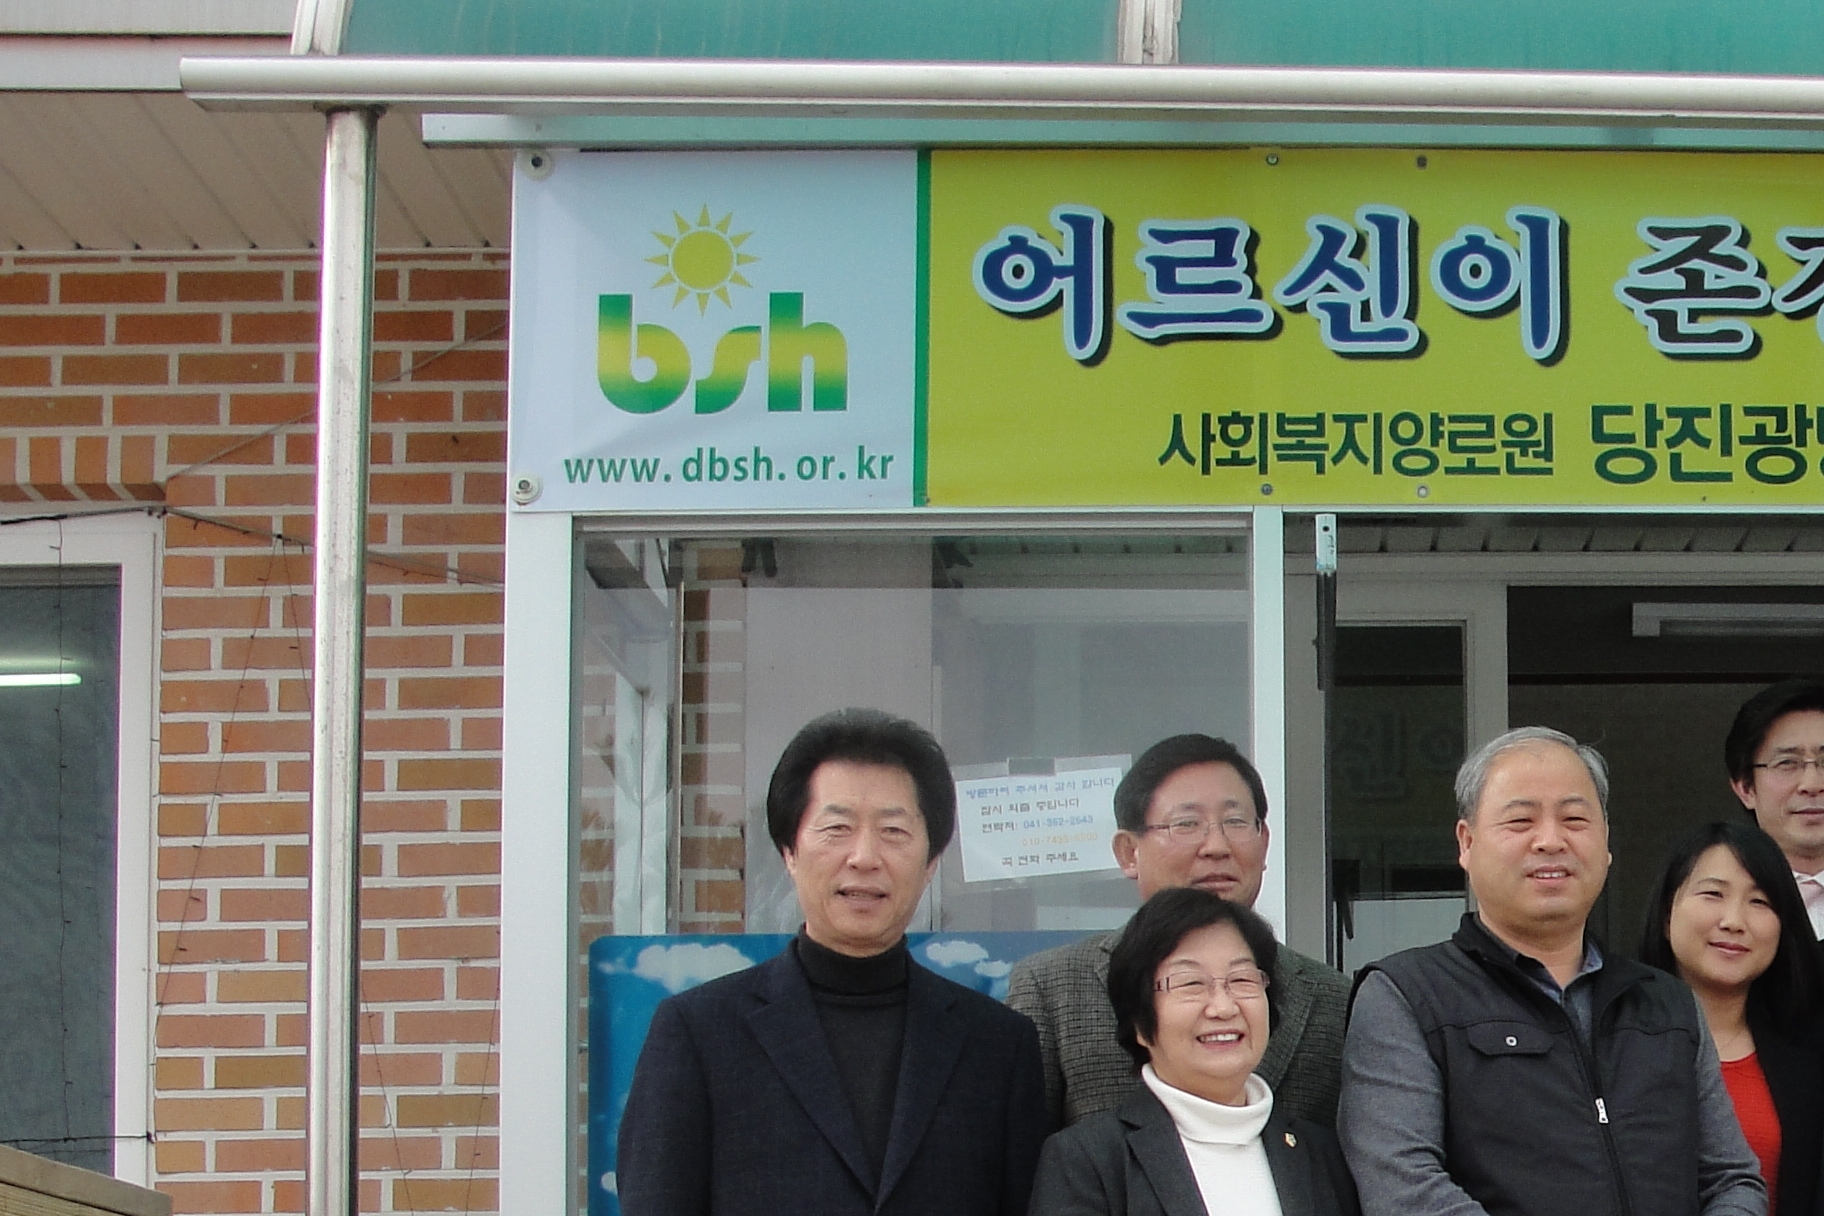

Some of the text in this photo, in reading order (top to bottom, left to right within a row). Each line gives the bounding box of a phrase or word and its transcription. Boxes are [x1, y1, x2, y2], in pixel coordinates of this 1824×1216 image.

[975, 203, 1567, 364] 어르신이
[598, 291, 848, 413] bsh
[563, 445, 896, 484] www.dbsh.or.kr
[1158, 408, 1555, 475] 사회복지양로원
